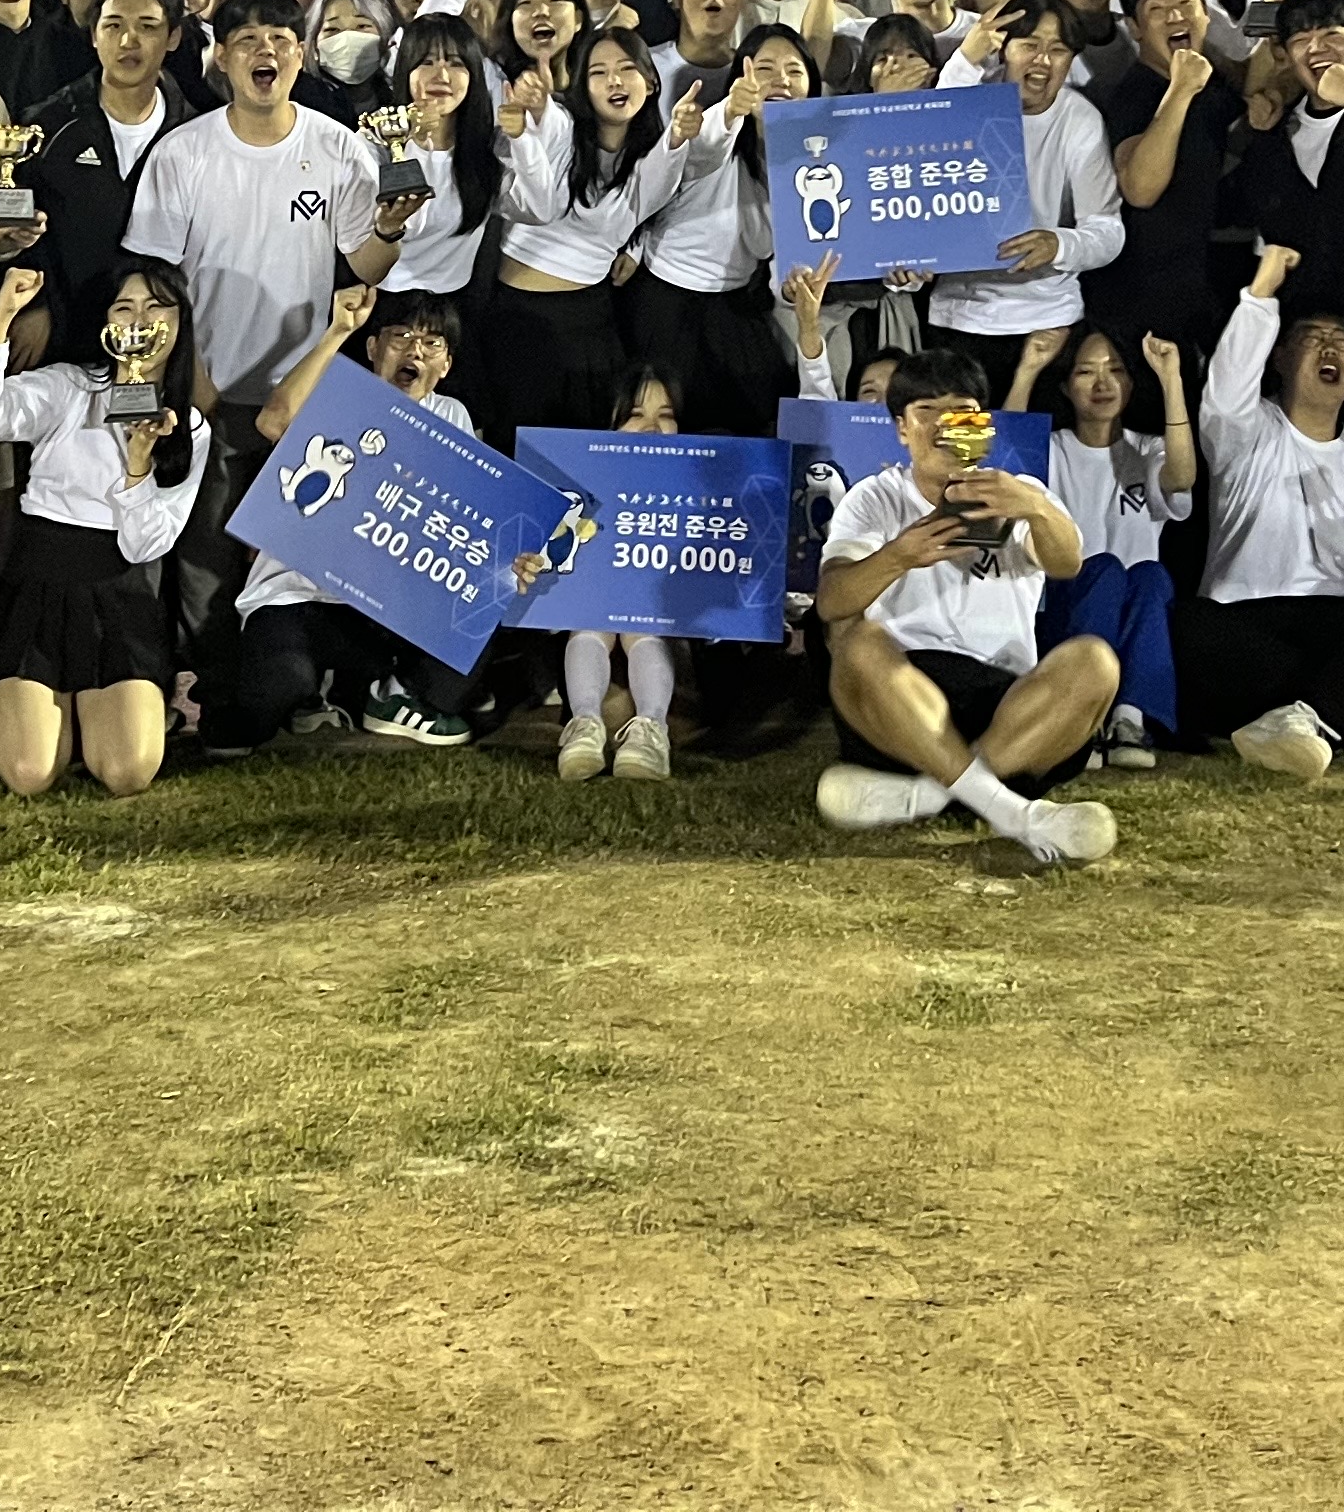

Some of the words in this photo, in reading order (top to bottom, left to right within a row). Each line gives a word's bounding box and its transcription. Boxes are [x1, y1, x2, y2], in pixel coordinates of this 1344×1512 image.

[867, 164, 913, 191] 종합
[919, 158, 989, 187] 준우승
[870, 190, 1000, 222] 500,000원
[374, 480, 423, 522] 배구
[421, 510, 490, 567] 준우승
[614, 511, 678, 537] 응원전
[685, 515, 749, 541] 준우승
[352, 511, 480, 604] 200,000원
[612, 542, 753, 575] 300,000원
